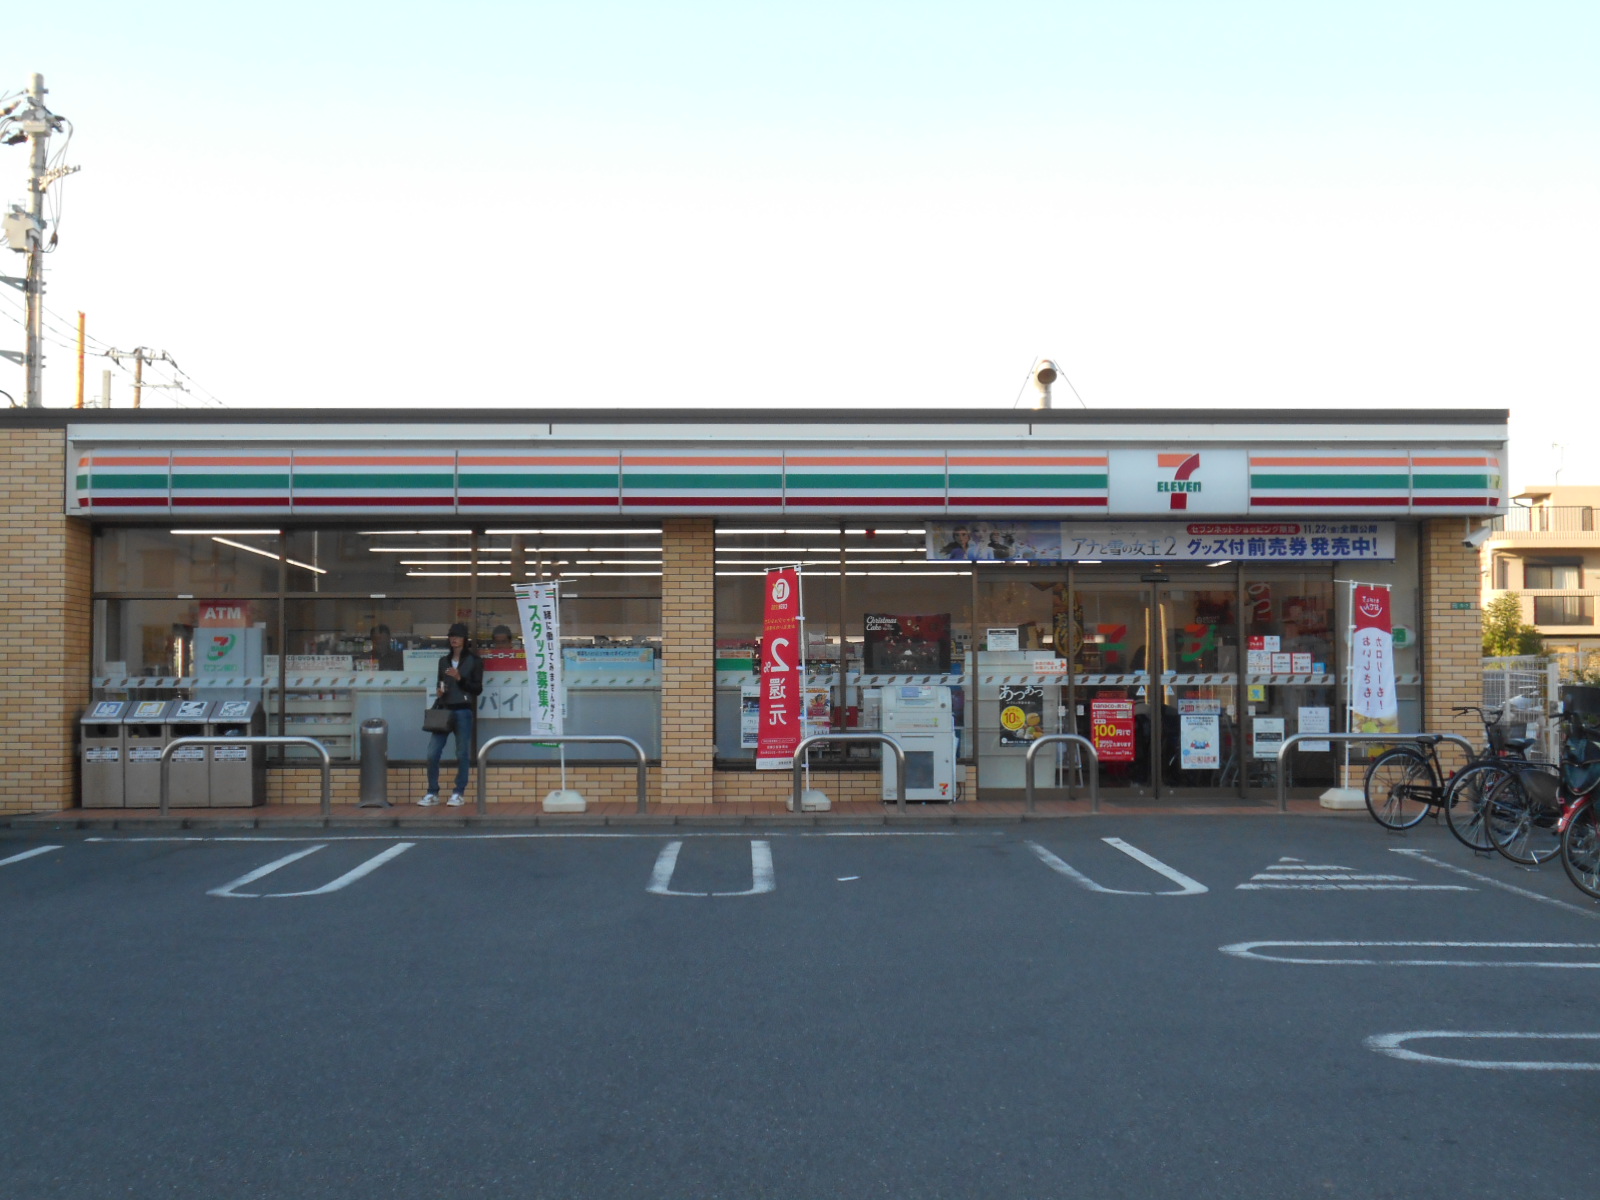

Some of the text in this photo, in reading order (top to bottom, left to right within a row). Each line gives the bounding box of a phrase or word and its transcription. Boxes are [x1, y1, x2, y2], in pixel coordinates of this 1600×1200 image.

[204, 607, 241, 619] ATM
[866, 615, 897, 624] Christmas
[527, 604, 550, 721] スタッフ募集!
